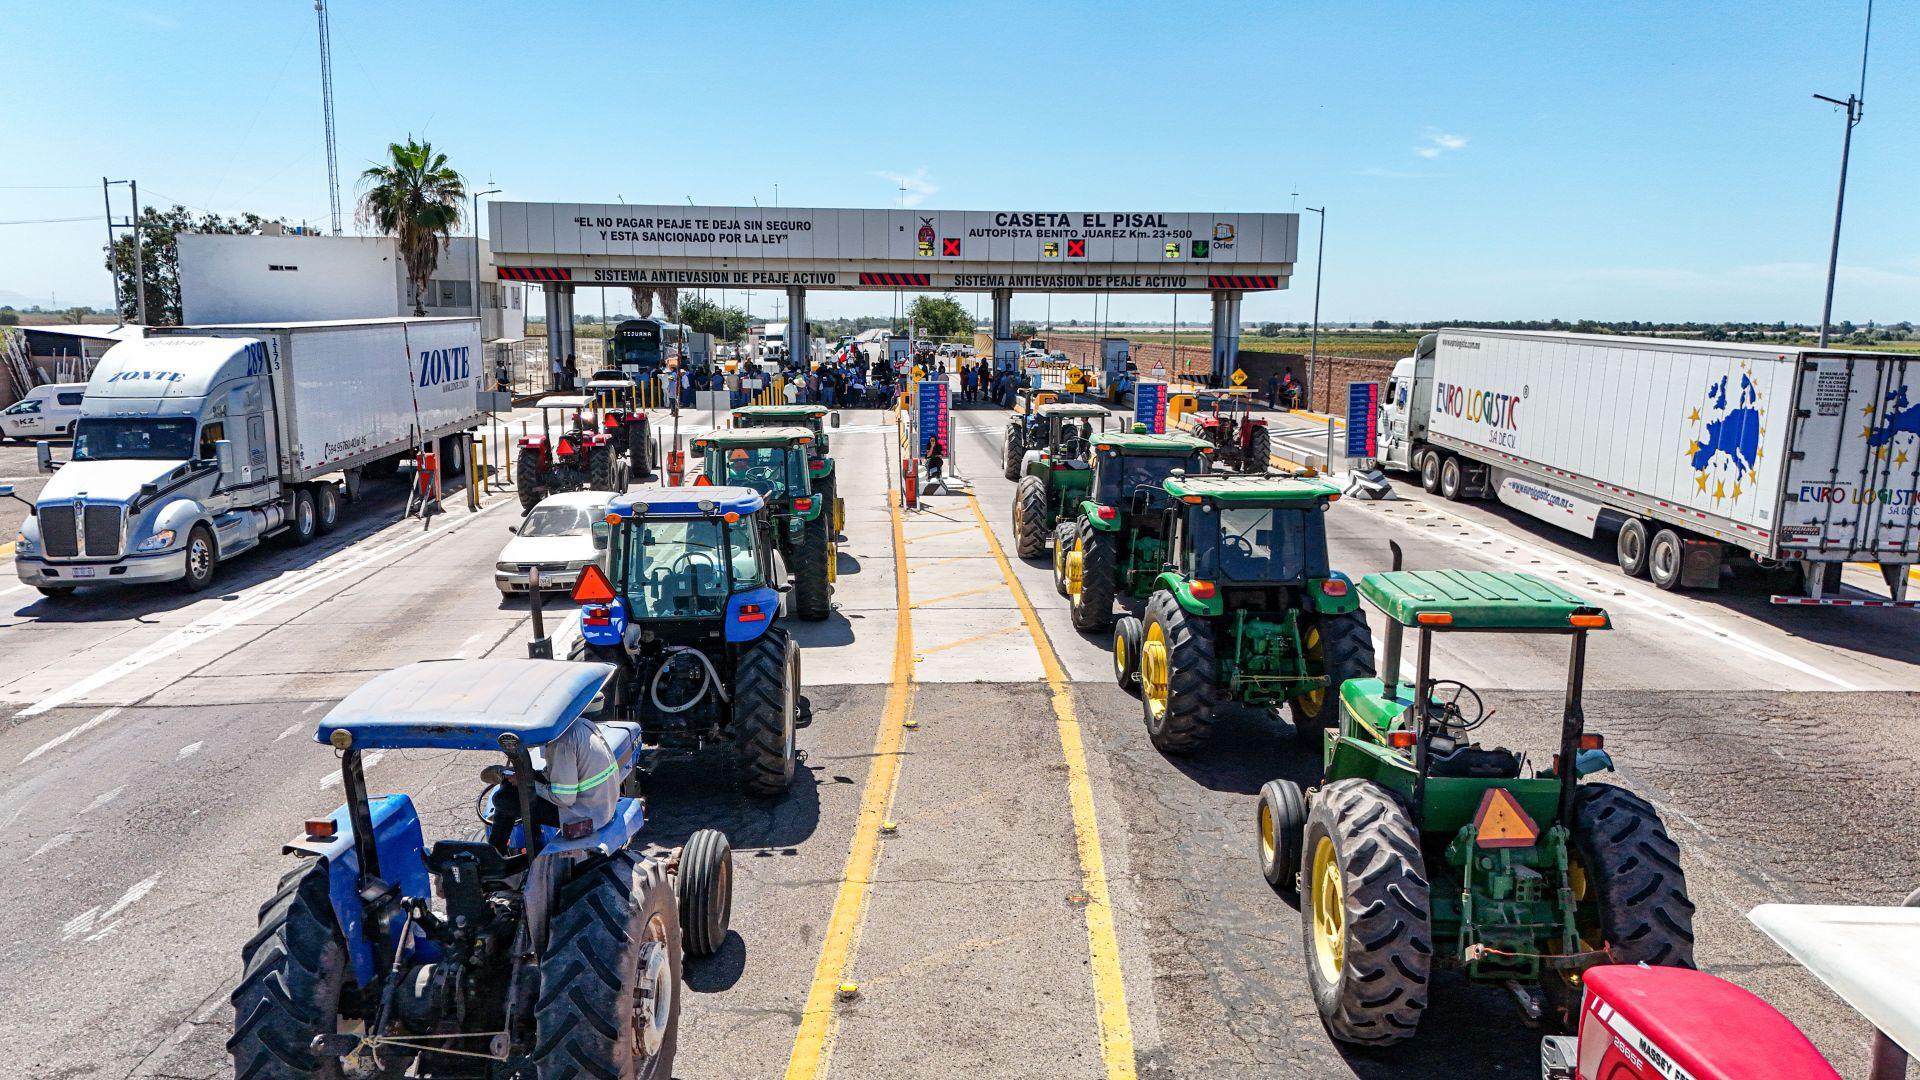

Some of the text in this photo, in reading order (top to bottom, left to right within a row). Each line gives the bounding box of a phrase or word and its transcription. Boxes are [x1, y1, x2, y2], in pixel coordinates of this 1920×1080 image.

[597, 217, 613, 228] NO
[616, 218, 654, 228] PAGAR
[657, 219, 692, 229] PEAJE
[695, 219, 709, 230] TE
[712, 220, 741, 230] DEJA
[744, 220, 763, 231] SIN
[766, 221, 812, 231] SEGURO
[995, 212, 1168, 228] CASETA EL PISAL
[600, 231, 608, 241] Y
[610, 231, 639, 241] ESTA
[642, 232, 716, 243] SANCIONADO
[719, 233, 742, 243] POR
[745, 234, 759, 243] LA
[968, 229, 1192, 239] AUTOPISTA BENITO JUAREZ Km. 23+500
[594, 269, 836, 284] SISTEMA ANTIEVASION DE PEAJE ACTIVO
[954, 275, 1187, 288] SISTEMA ANTIEVASION DE PEAJE ACTIVO
[244, 341, 263, 377] 289
[271, 337, 281, 370] 1173
[420, 346, 470, 387] ZONTE
[107, 370, 186, 383] ZONTE
[1436, 382, 1520, 431] EURO LOGISTIC
[1800, 486, 1845, 503] EURO
[1639, 1037, 1672, 1074] MASSEY
